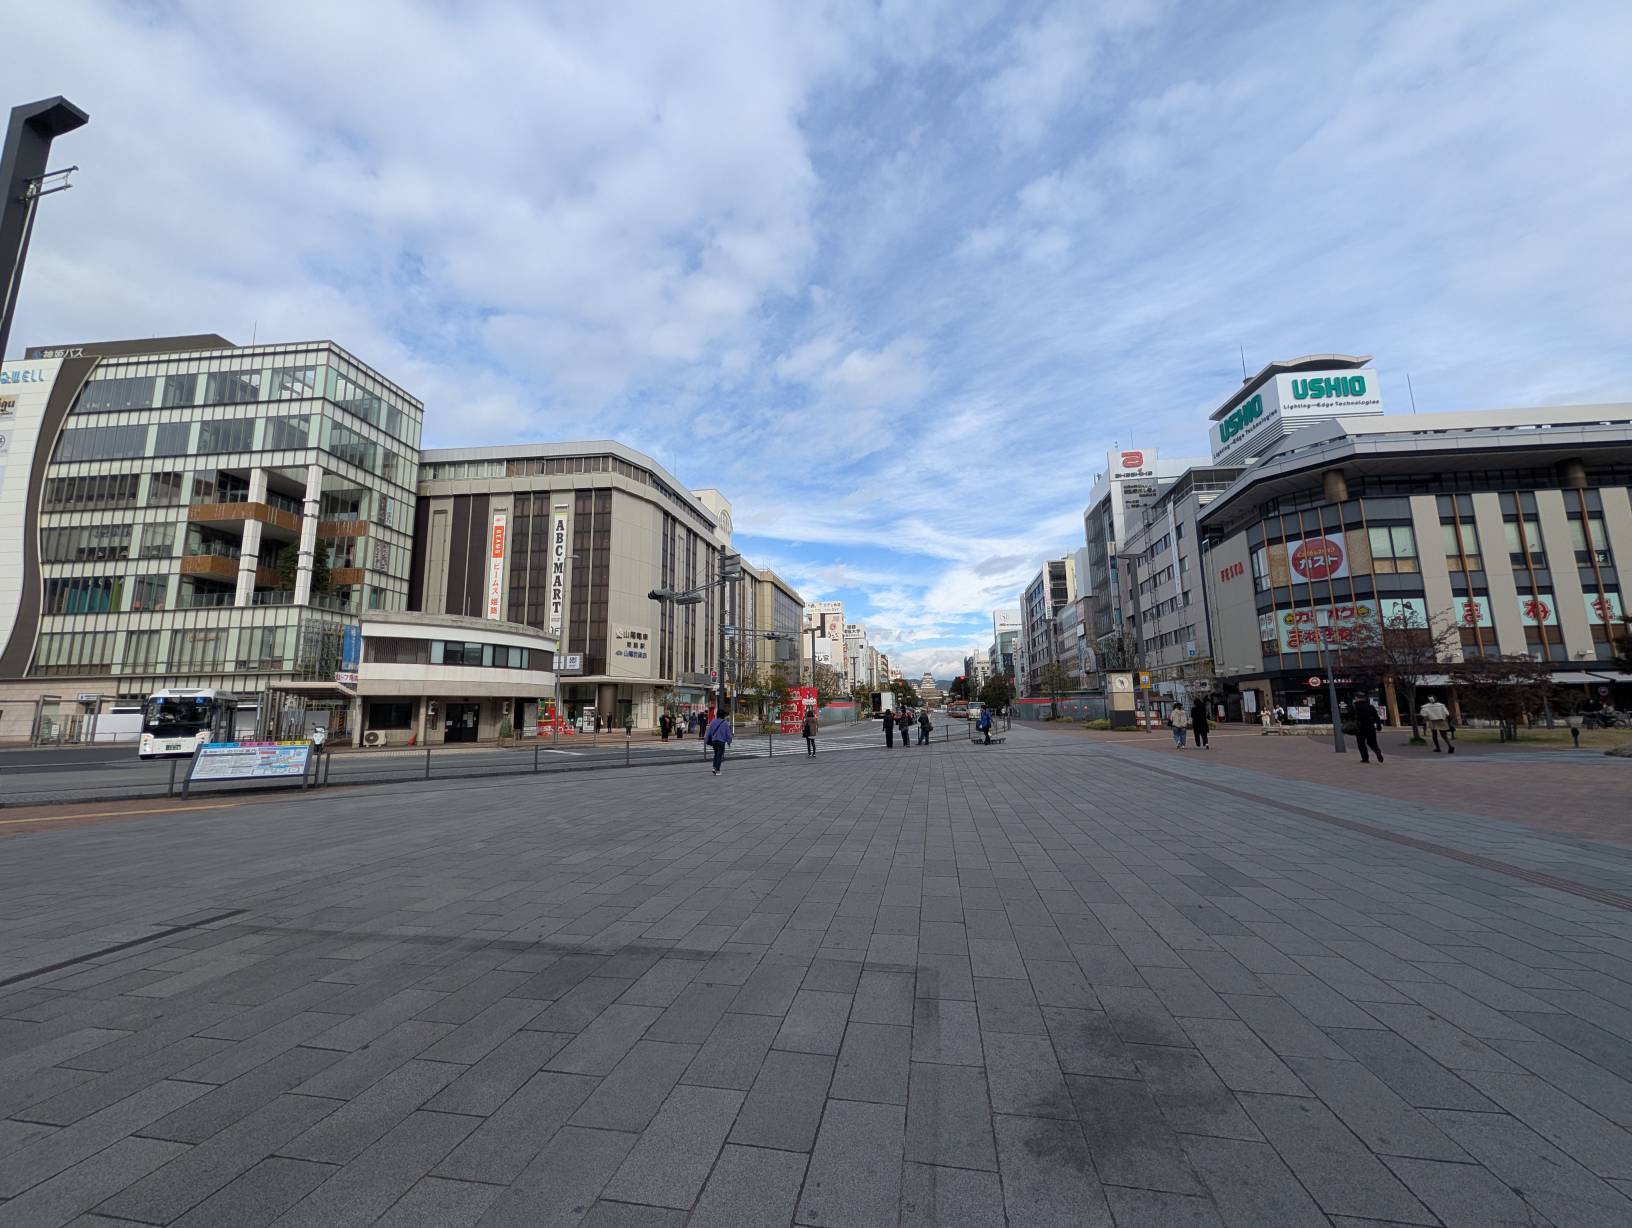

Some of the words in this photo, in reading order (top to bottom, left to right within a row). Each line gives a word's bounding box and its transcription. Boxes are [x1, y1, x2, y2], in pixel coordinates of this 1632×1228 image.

[1291, 375, 1367, 400] USHIO
[1335, 399, 1380, 407] Technologies
[1219, 394, 1264, 443] USHIO
[1299, 555, 1338, 569] ガスト
